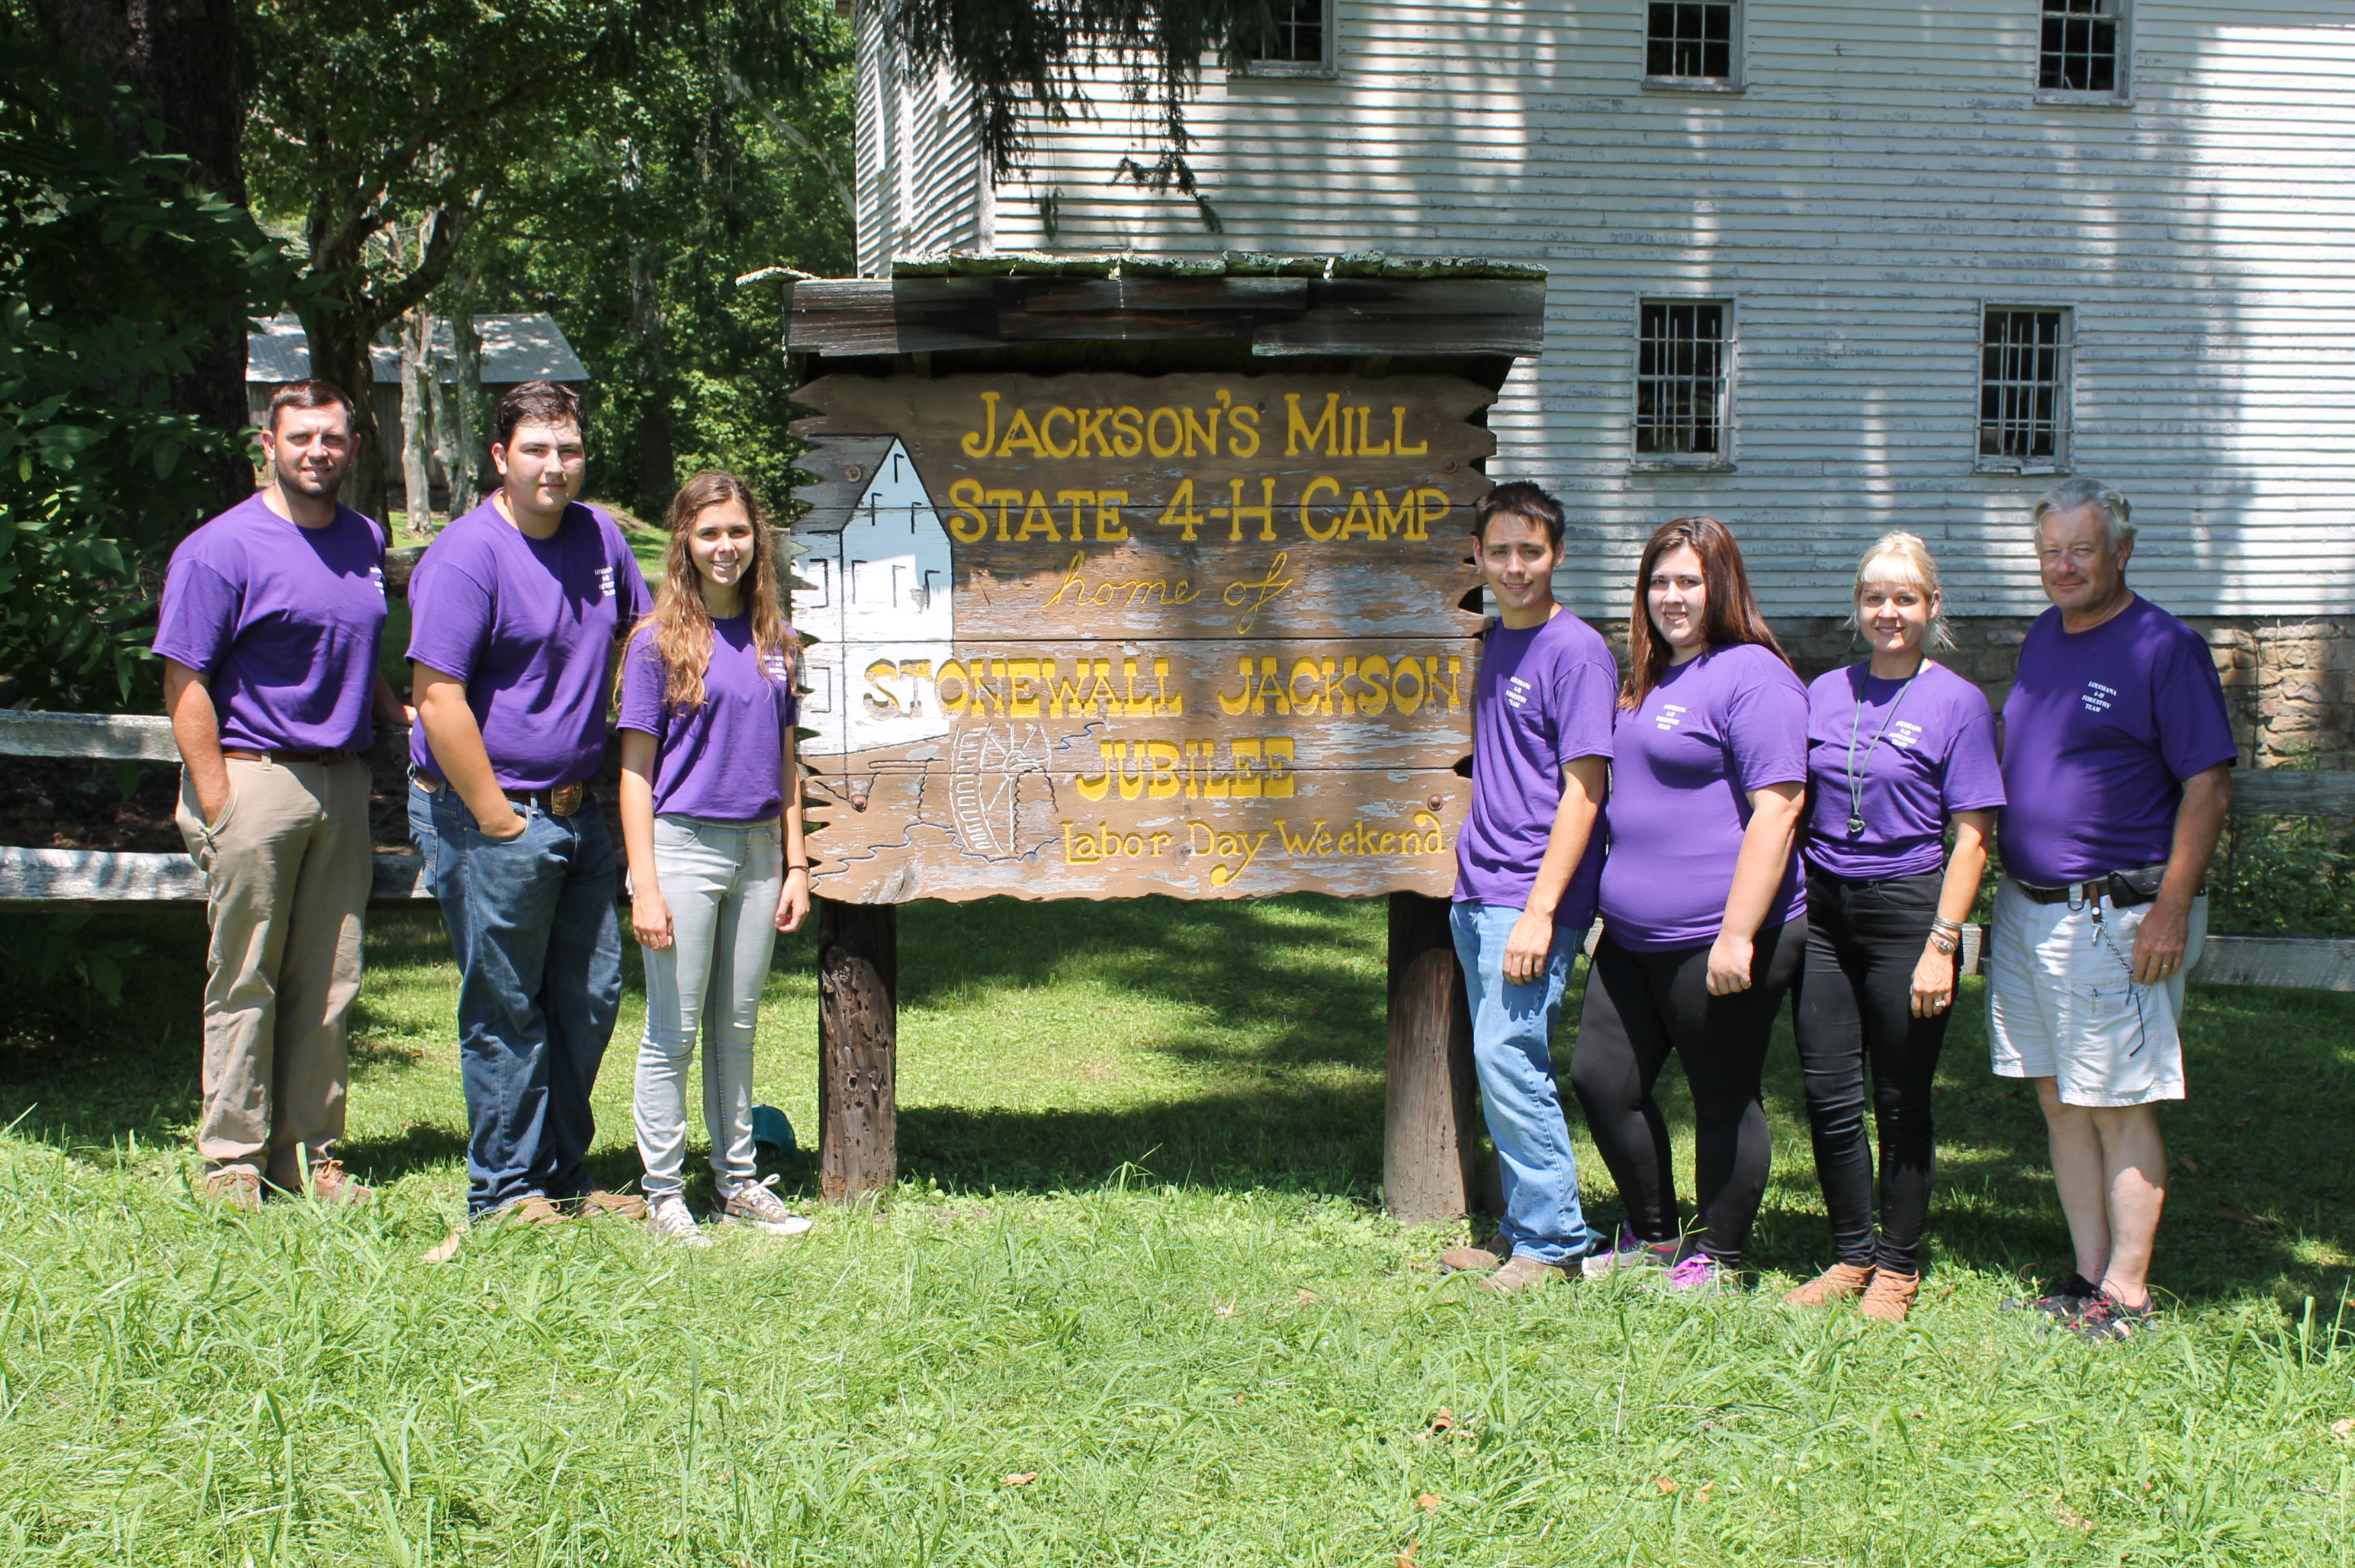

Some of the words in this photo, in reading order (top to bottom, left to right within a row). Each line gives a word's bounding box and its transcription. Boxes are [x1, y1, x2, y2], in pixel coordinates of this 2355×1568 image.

[1284, 393, 1428, 458] MILL
[948, 477, 1129, 544] STATE
[1158, 478, 1277, 542] 4-H
[1300, 476, 1451, 542] CAMP
[1042, 550, 1201, 608] home
[1222, 551, 1293, 635] of
[863, 657, 1184, 720] STONEWALL
[1217, 654, 1462, 717] JACKSON
[2081, 695, 2112, 709] FORESTRY
[2085, 703, 2101, 713] TEAM
[1076, 736, 1295, 801] JUBILEE
[1060, 819, 1172, 865] Labor
[1187, 819, 1272, 887] Day
[1273, 810, 1447, 856] Weekend
